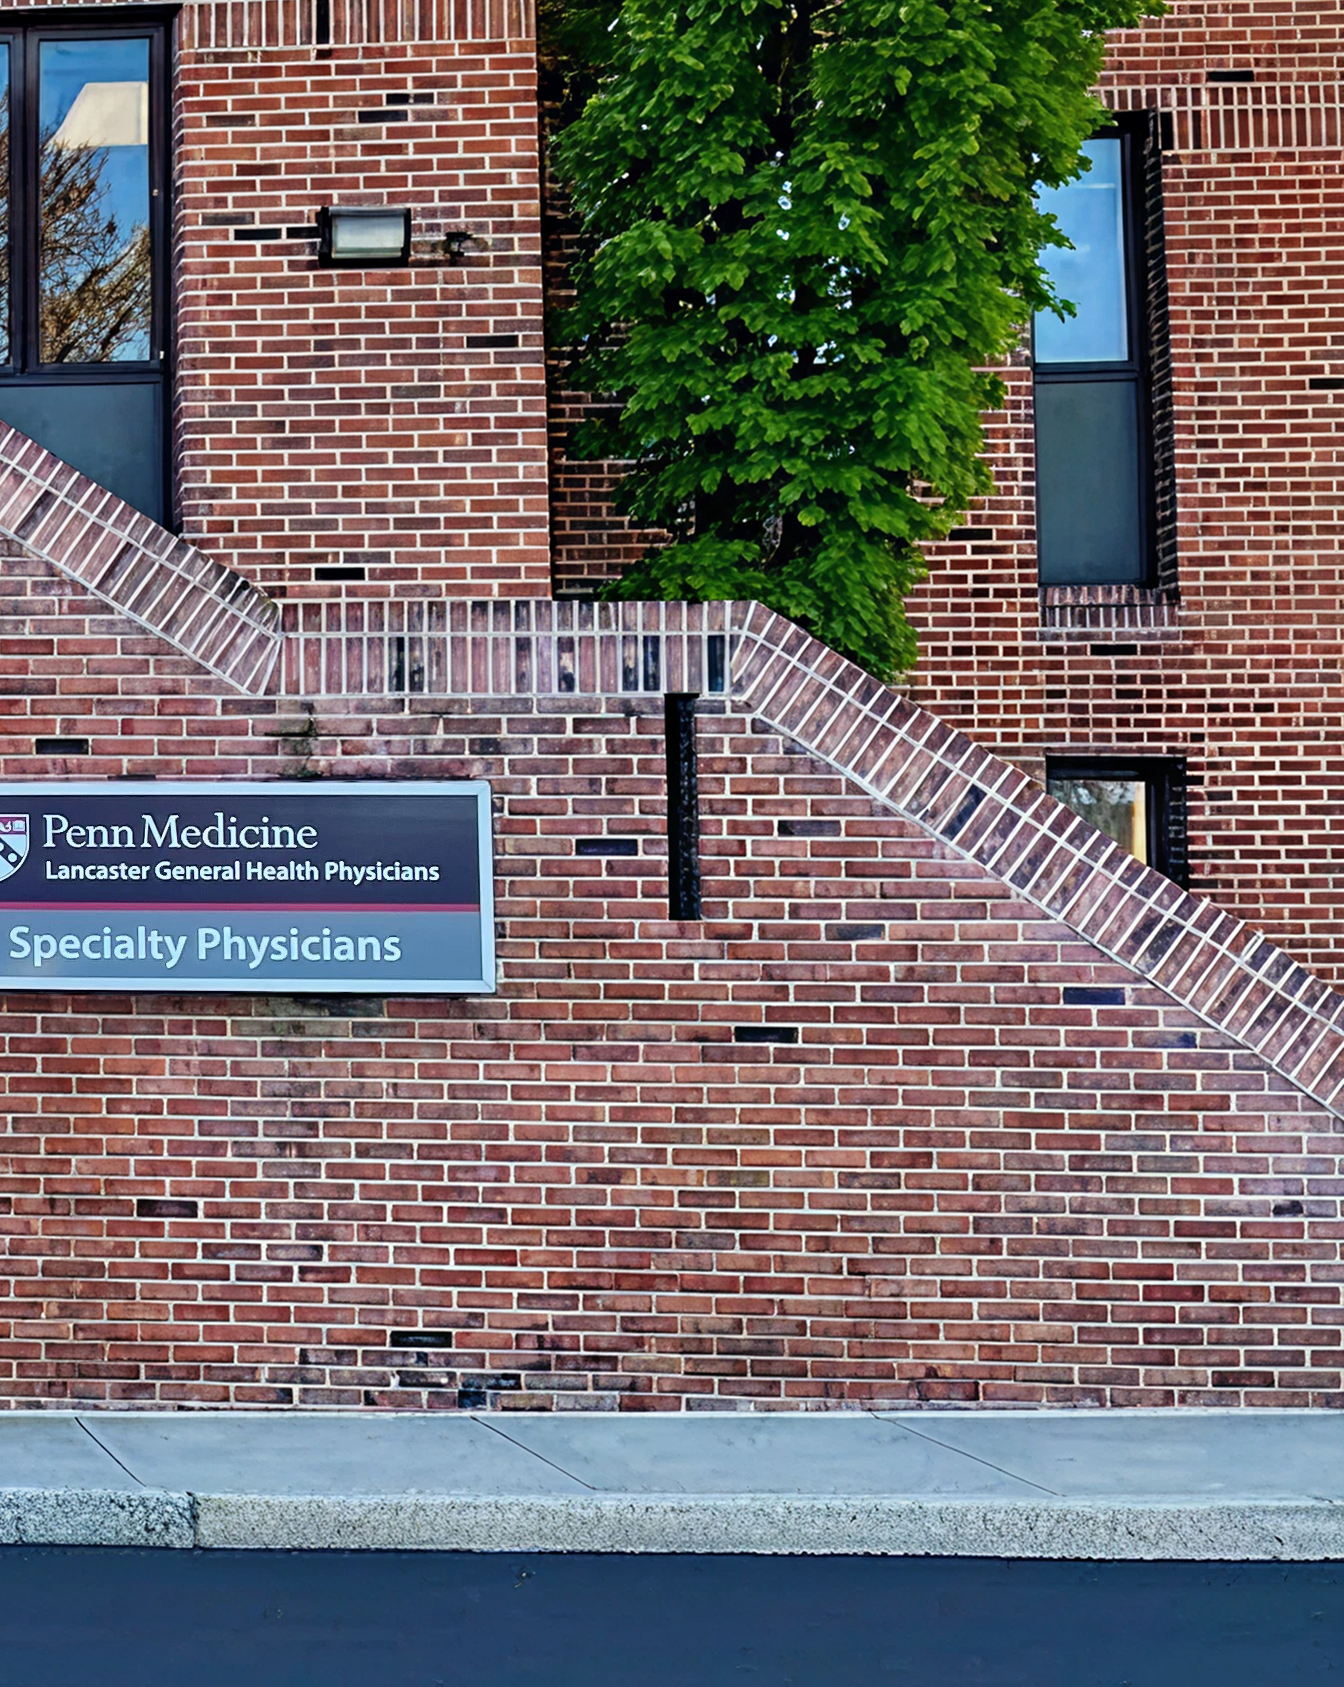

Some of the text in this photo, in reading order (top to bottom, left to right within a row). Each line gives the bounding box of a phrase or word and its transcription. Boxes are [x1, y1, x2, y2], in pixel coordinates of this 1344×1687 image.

[42, 812, 318, 849] Penn Medicine
[45, 860, 440, 886] Lancaster General Health Physicians
[9, 925, 402, 970] Specialty Physicians
